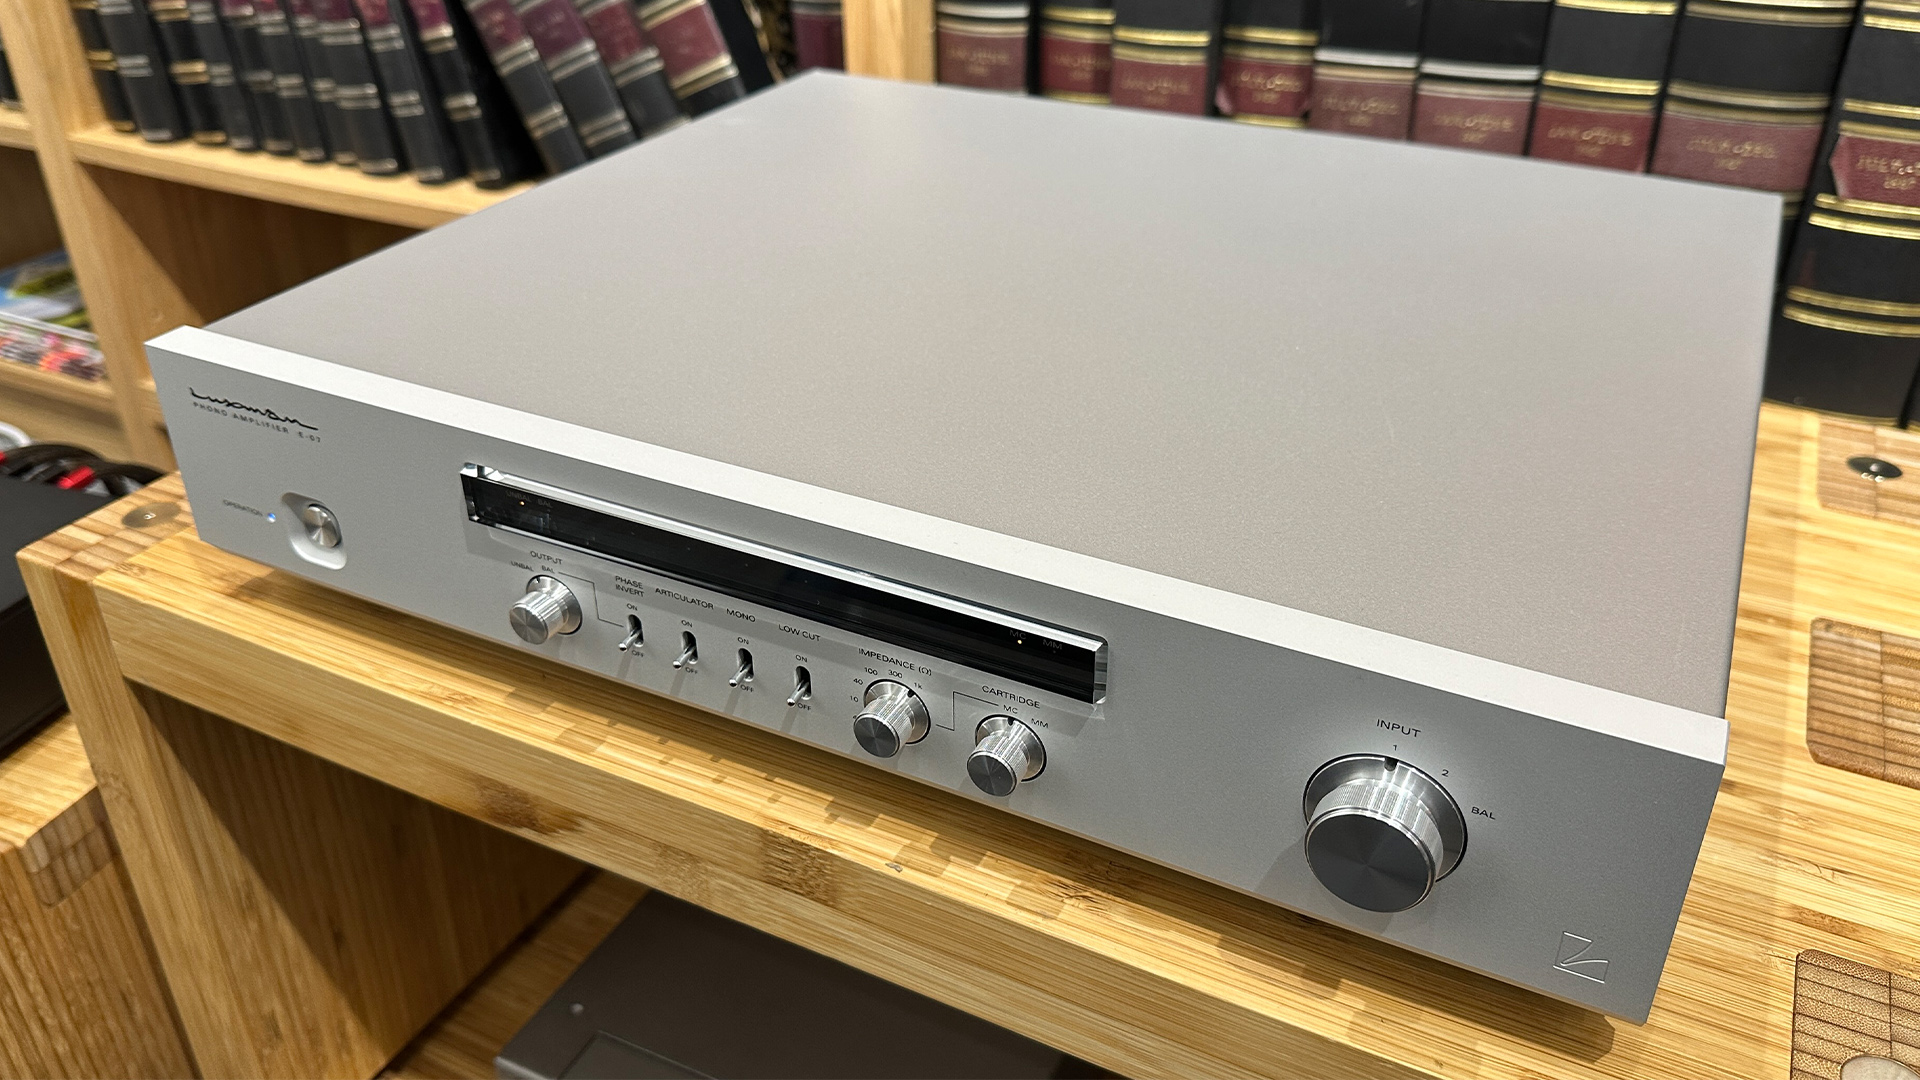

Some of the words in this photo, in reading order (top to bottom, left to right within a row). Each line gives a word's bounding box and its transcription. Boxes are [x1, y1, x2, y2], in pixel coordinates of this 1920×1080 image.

[193, 401, 229, 416] PHONO
[232, 412, 290, 434] AMPLIFIER
[298, 431, 321, 442] E-07
[222, 499, 263, 517] OPERATION
[530, 550, 563, 565] OUTPUT
[510, 560, 535, 572] UNBAL
[541, 565, 556, 574] BAL
[615, 575, 644, 589] PHASE
[615, 584, 645, 597] INVERT
[655, 587, 714, 610] ARTICULATOR
[626, 602, 638, 611] ON
[726, 608, 756, 623] MONO
[681, 619, 693, 628] ON
[778, 623, 800, 636] LOW
[801, 630, 821, 642] CUT
[737, 636, 749, 645] ON
[1009, 629, 1027, 640] MC
[1042, 638, 1063, 650] MM
[631, 649, 644, 658] OFF
[795, 654, 808, 663] ON
[858, 647, 915, 671] IMPEDANCE
[685, 666, 698, 675] OFF
[863, 666, 878, 676] 100
[887, 669, 903, 679] 300
[852, 677, 864, 686] 40
[740, 683, 754, 693] OFF
[849, 695, 859, 703] 10
[981, 685, 1041, 709] CARTRIDGE
[797, 702, 812, 712] OFF
[1003, 704, 1019, 715] MC
[1030, 718, 1049, 729] MM
[1376, 718, 1422, 738] INPUT
[1392, 744, 1398, 752] 1
[1441, 769, 1450, 777] 2
[1470, 806, 1497, 820] BAL
